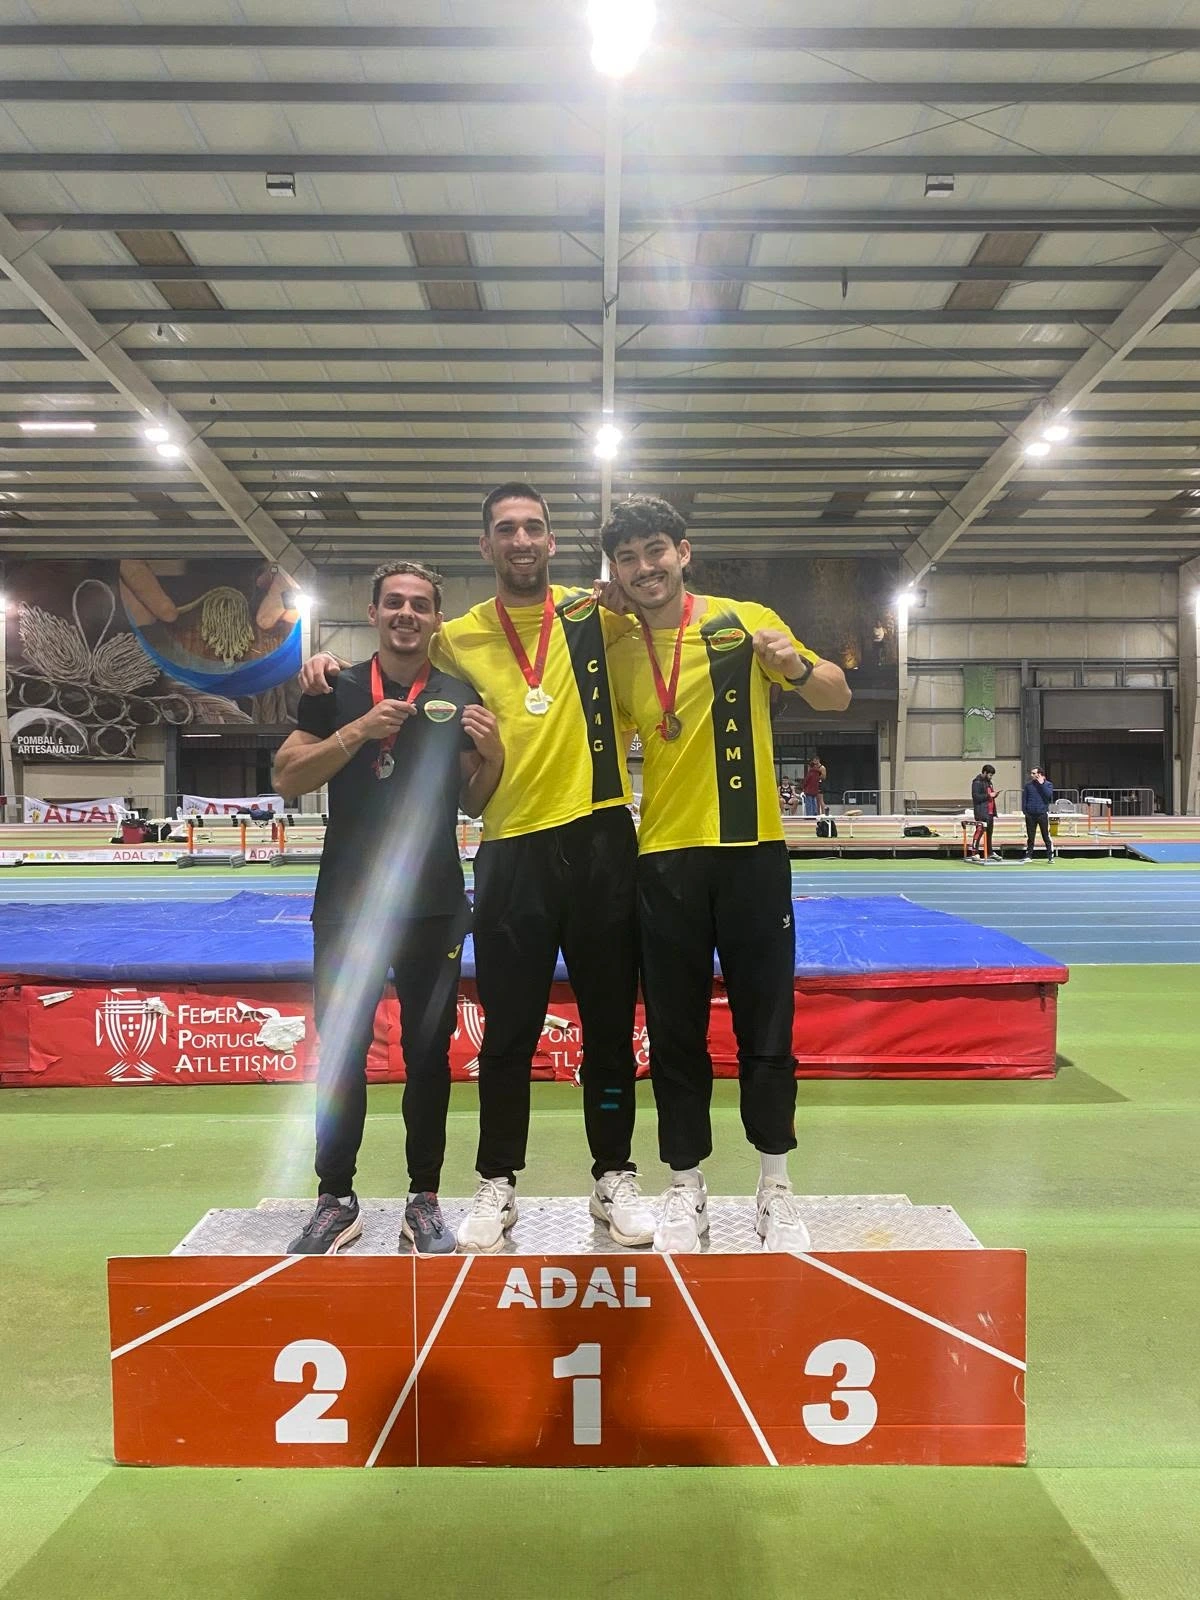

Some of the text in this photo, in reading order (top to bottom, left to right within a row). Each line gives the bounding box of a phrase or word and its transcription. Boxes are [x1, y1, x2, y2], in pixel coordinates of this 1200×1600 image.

[17, 736, 55, 745] POMBAL
[17, 745, 80, 754] ARTESANATO!
[725, 689, 742, 789] CAMG
[113, 851, 145, 861] ADAL
[174, 1054, 297, 1073] ATLETISMO
[497, 1267, 651, 1309] ADAL
[273, 1339, 348, 1444] 2
[553, 1342, 601, 1445] 1
[802, 1338, 878, 1445] 3
